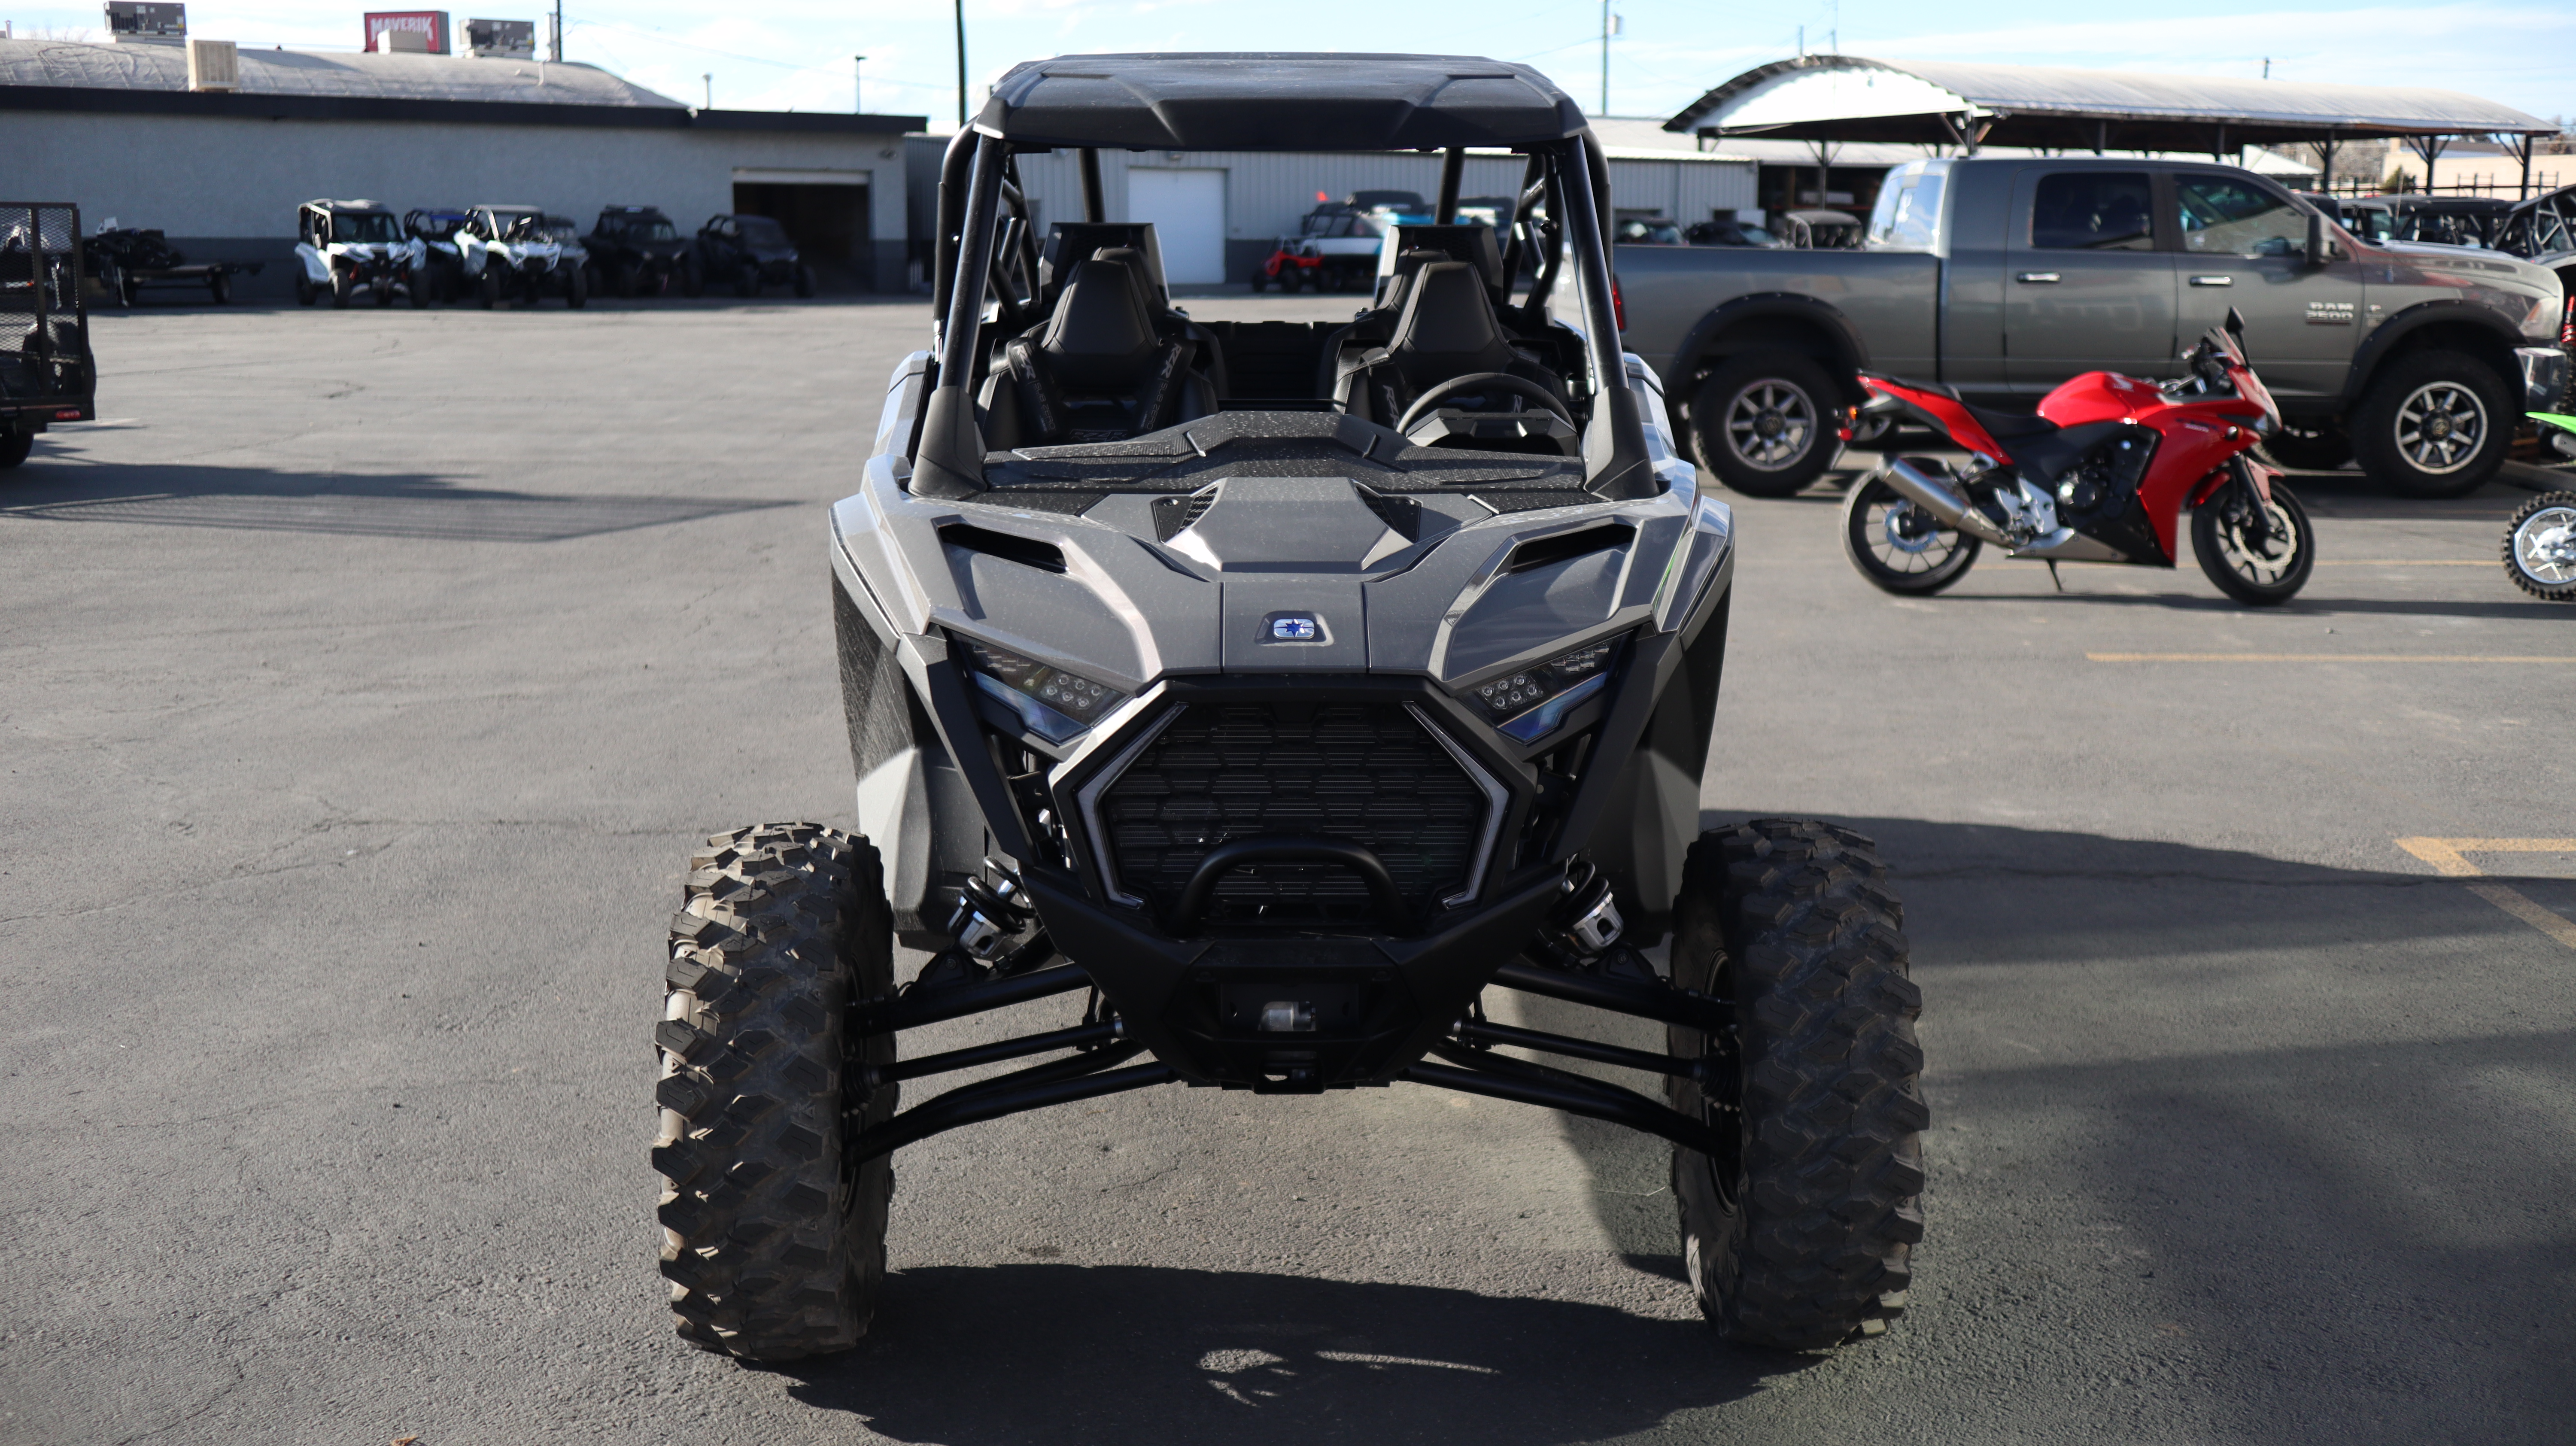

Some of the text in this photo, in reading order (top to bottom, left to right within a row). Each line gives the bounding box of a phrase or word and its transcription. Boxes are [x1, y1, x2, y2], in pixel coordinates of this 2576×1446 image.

[370, 16, 434, 43] MAVERIK
[1013, 344, 1036, 379] RZR
[1162, 343, 1182, 379] RZR
[1034, 382, 1047, 402] SUB
[1042, 404, 1056, 431] ZERO
[1147, 382, 1168, 430] SUB ZERO
[1069, 428, 1128, 442] RZR
